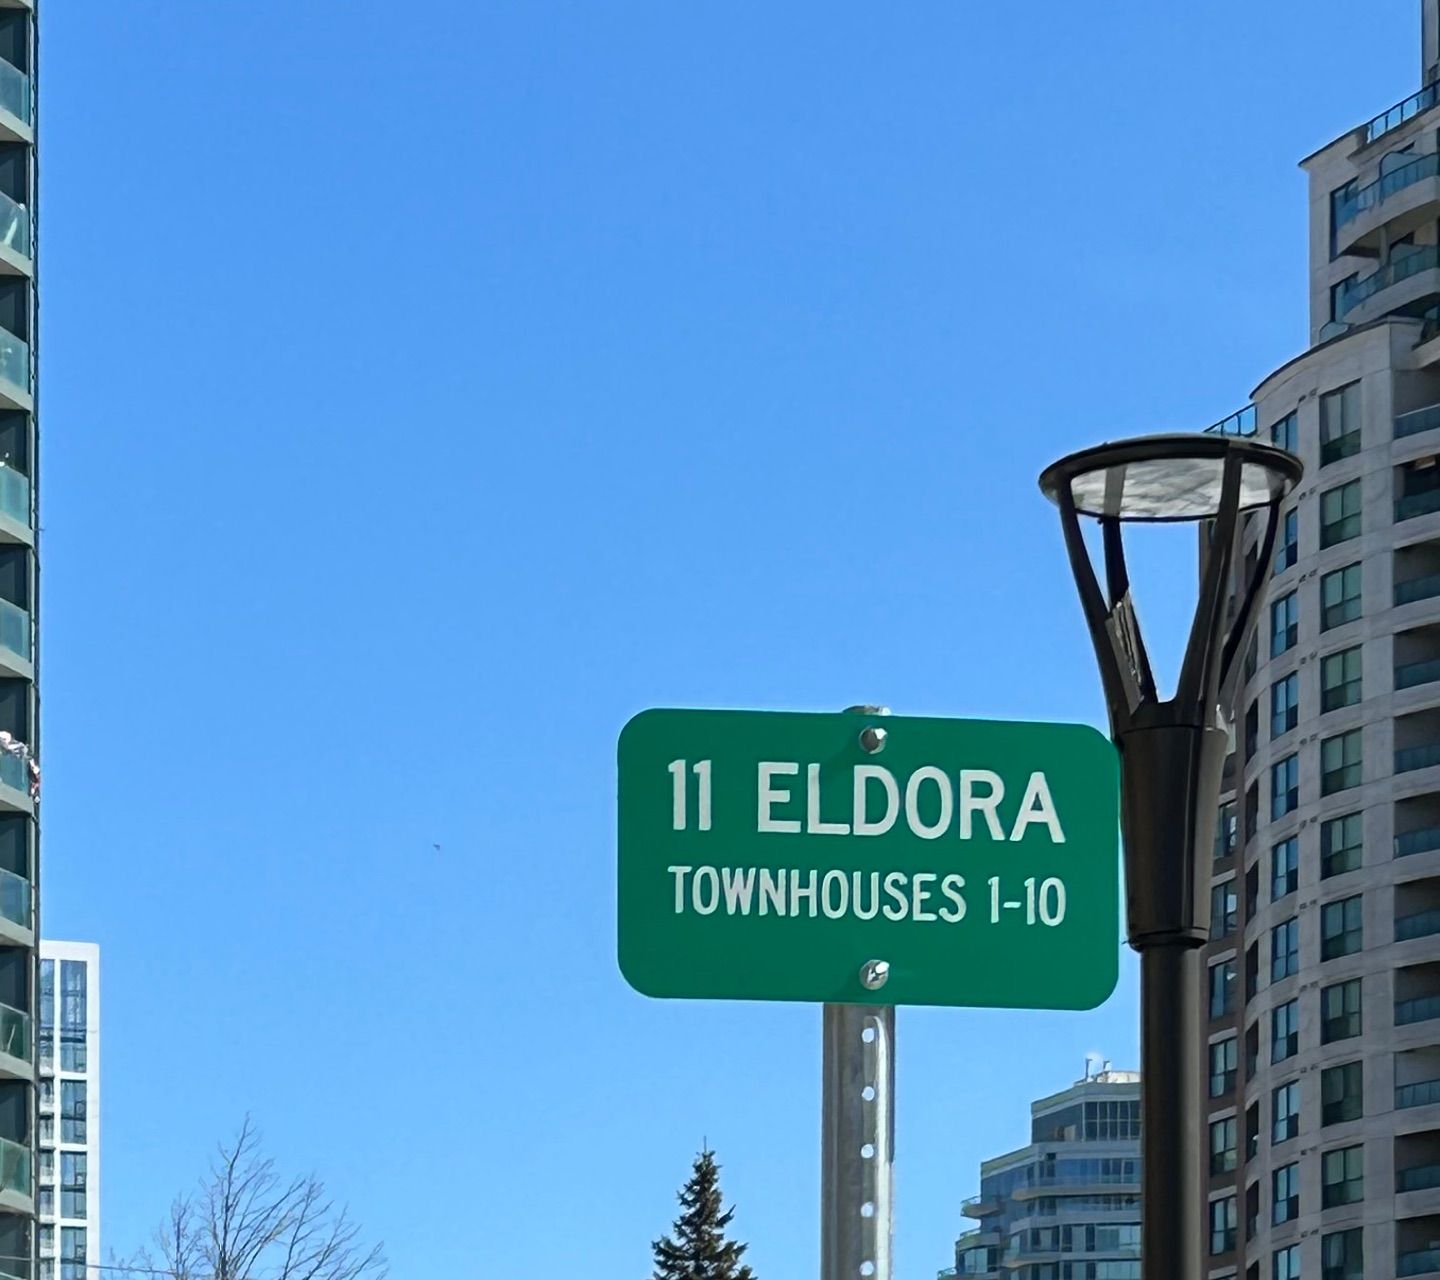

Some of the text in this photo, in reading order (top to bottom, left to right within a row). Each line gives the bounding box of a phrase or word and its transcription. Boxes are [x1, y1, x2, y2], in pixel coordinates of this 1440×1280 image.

[667, 759, 1067, 844] 11 ELDORA
[667, 865, 1067, 927] TOWNHOUSES 1-10
